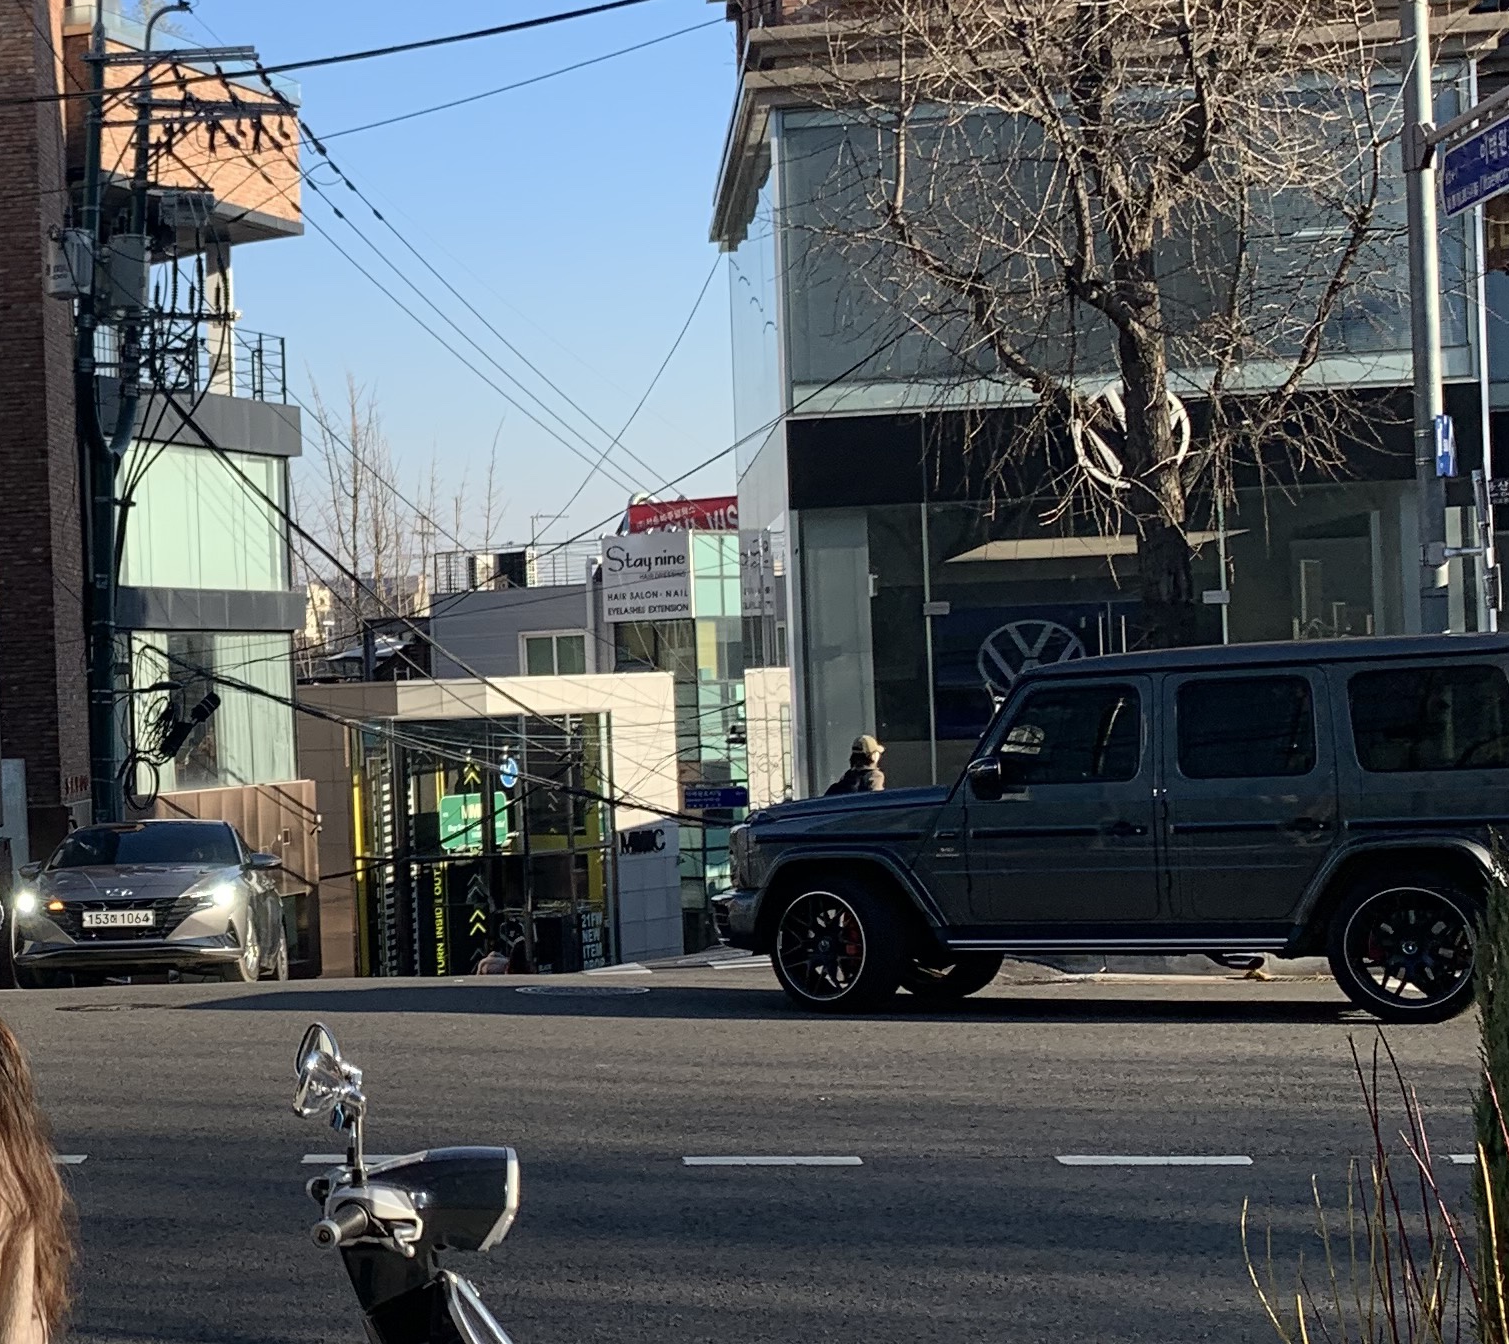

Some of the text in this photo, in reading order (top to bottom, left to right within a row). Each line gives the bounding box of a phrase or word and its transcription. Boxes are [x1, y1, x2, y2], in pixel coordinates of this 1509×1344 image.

[606, 545, 685, 572] Stay nine
[607, 588, 689, 602] HAIR SALON NAIL
[607, 603, 689, 616] EYELASHES EXTENSION
[433, 868, 442, 896] OUT
[120, 912, 150, 924] 1064
[582, 928, 601, 943] NEW
[583, 942, 602, 959] ITEM
[436, 942, 445, 976] TURN
